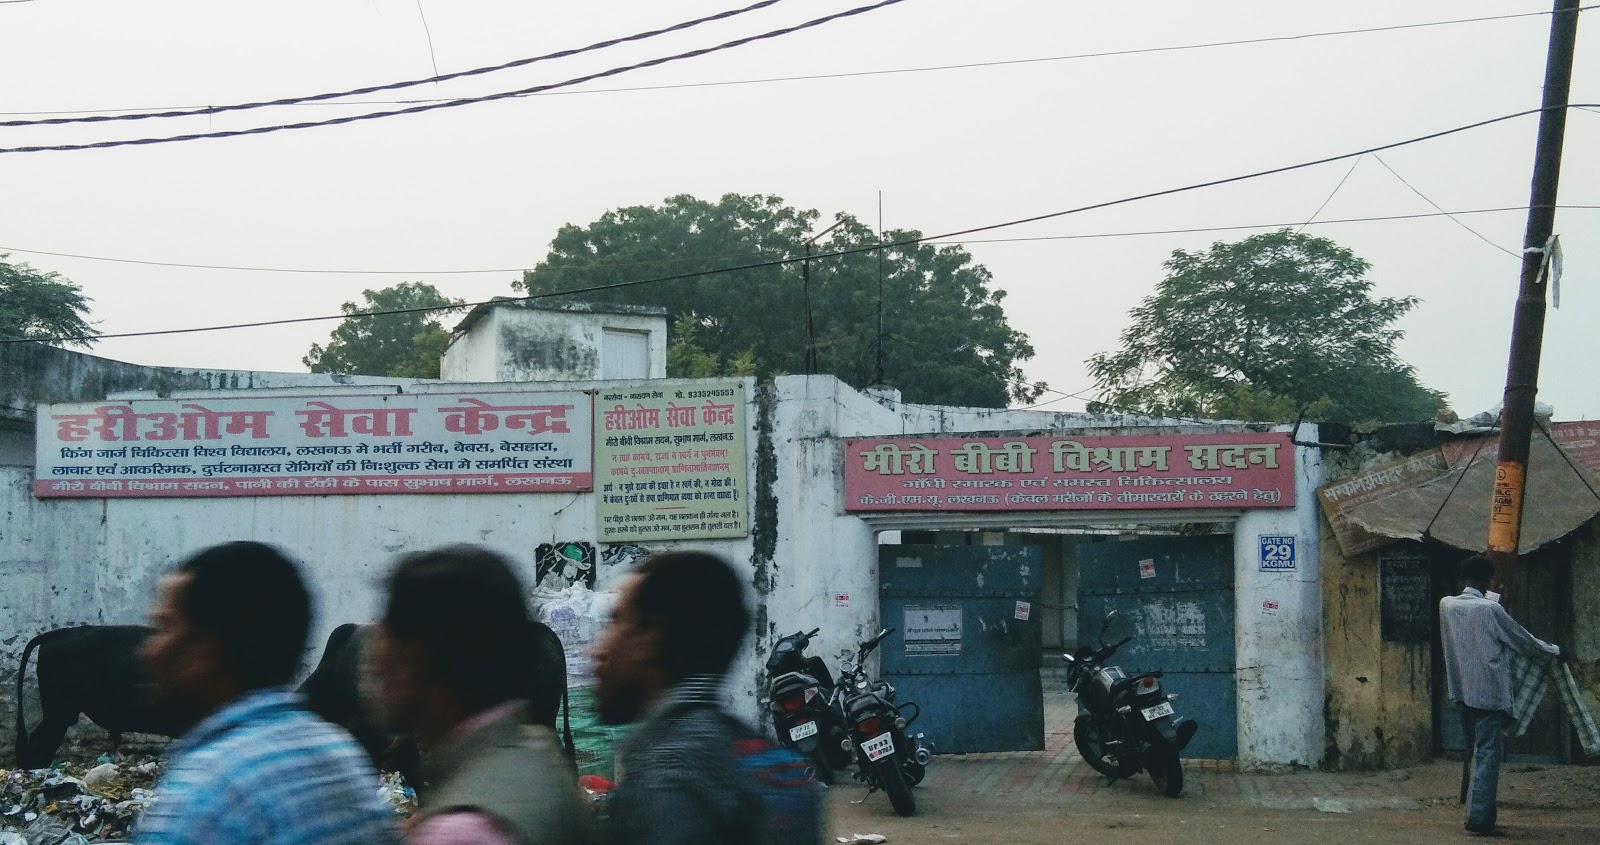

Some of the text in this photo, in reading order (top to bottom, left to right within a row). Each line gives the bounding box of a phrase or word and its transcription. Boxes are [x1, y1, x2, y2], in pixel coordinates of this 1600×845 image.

[52, 398, 574, 441] हरीओम सेवा केन्द्र
[603, 400, 734, 431] हरीओम सेवा केन्द्र
[634, 435, 653, 445] विश्राम
[674, 435, 691, 446] सुभाष
[710, 433, 734, 442] लखनऊ
[61, 447, 92, 458] किंग
[96, 447, 127, 459] जार्ज
[131, 446, 189, 458] चिकित्सा
[194, 446, 226, 458] विश्व
[231, 446, 291, 457] विद्यालय,
[296, 446, 352, 455] लखनऊ
[374, 442, 402, 454] भर्ती
[407, 443, 448, 454] गरीब,
[454, 441, 494, 453] बेबस,
[500, 440, 557, 453] बेसहारा,
[860, 440, 1281, 475] मीरो बीबी विश्राम सदन
[52, 466, 92, 476] लाचार
[96, 463, 118, 475] एवं
[120, 465, 196, 475] आकस्मिक,
[202, 462, 281, 477] दुर्घटनाग्रस्त
[286, 461, 333, 472] रोगियों
[336, 461, 356, 472] की
[360, 460, 421, 473] निःशुल्क
[425, 459, 454, 470] सेवा
[475, 458, 529, 469] समर्पित
[533, 456, 573, 469] संस्था
[89, 480, 122, 491] बीबी
[128, 481, 179, 491] विश्राम
[184, 481, 229, 490] सदन,
[235, 479, 272, 489] पानी
[276, 479, 299, 489] की
[343, 477, 361, 487] के
[365, 478, 398, 487] पास
[404, 477, 451, 489] सुभाष
[456, 476, 499, 487] मार्ग,
[505, 477, 572, 486] लखनऊ
[649, 481, 656, 490] की
[952, 479, 1013, 488] स्मारक
[1019, 477, 1049, 487] एवं
[1053, 479, 1111, 487] समस्त
[1117, 476, 1233, 487] चिकित्सालय
[695, 491, 702, 500] को
[947, 494, 999, 504] लखनऊ
[1004, 492, 1049, 506] (केवल
[1052, 491, 1096, 503] मरीजों
[1098, 492, 1113, 502] के
[1117, 489, 1186, 502] तीमारदारों
[1189, 491, 1204, 501] के
[1209, 489, 1248, 501] ठहरने
[700, 522, 706, 530] ही
[1265, 545, 1291, 560] 29
[868, 743, 878, 751] UP
